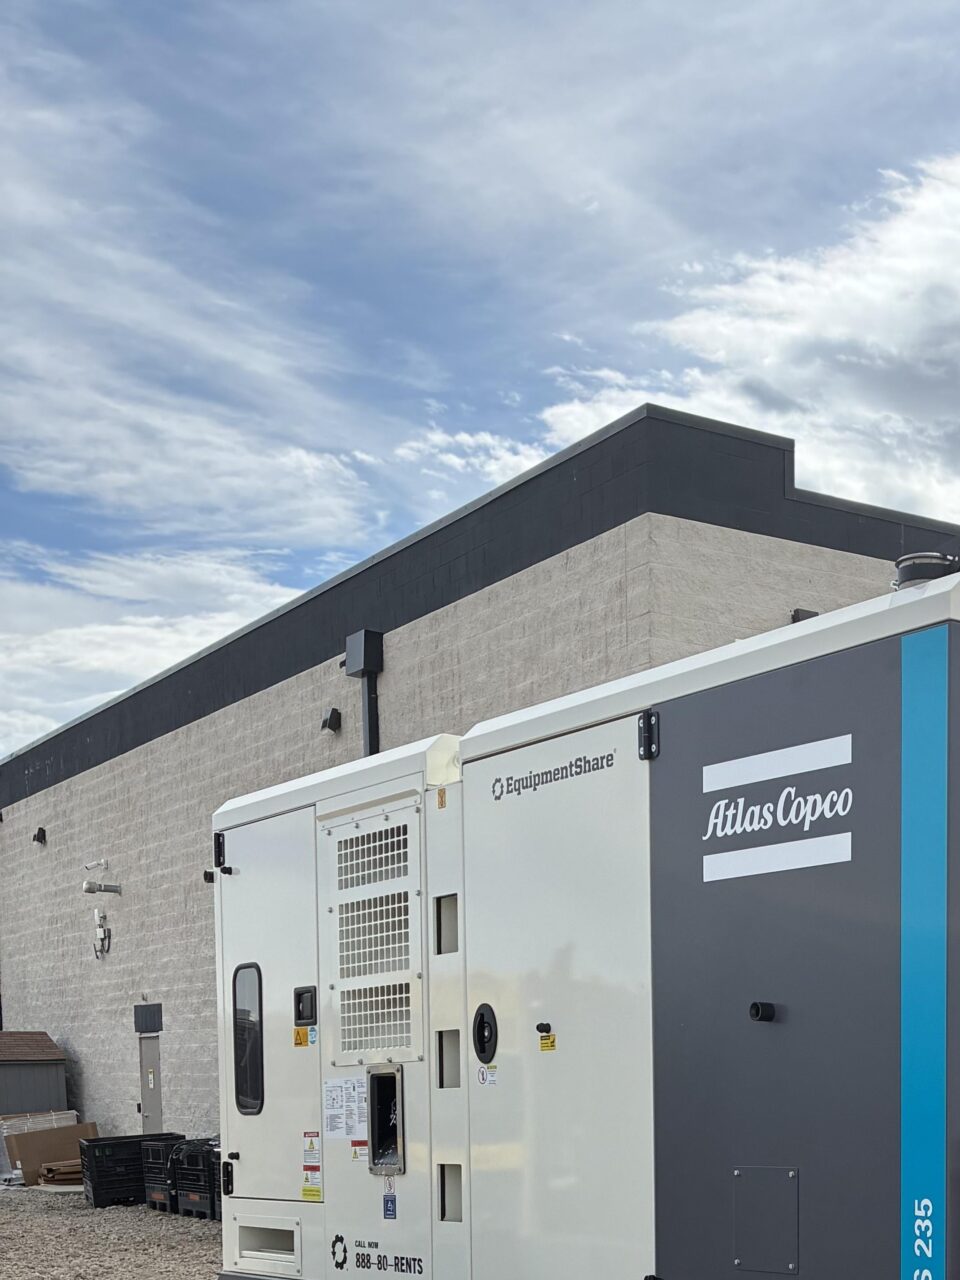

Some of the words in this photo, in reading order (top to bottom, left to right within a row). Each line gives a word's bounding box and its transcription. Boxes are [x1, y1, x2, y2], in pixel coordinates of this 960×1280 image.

[506, 753, 615, 796] EquipmentShare
[702, 797, 774, 841] Atlas
[776, 786, 853, 832] Copco
[354, 1240, 366, 1248] CALL
[367, 1241, 379, 1249] NOW
[914, 1198, 933, 1258] 235
[355, 1252, 424, 1275] 888-80-RENTS
